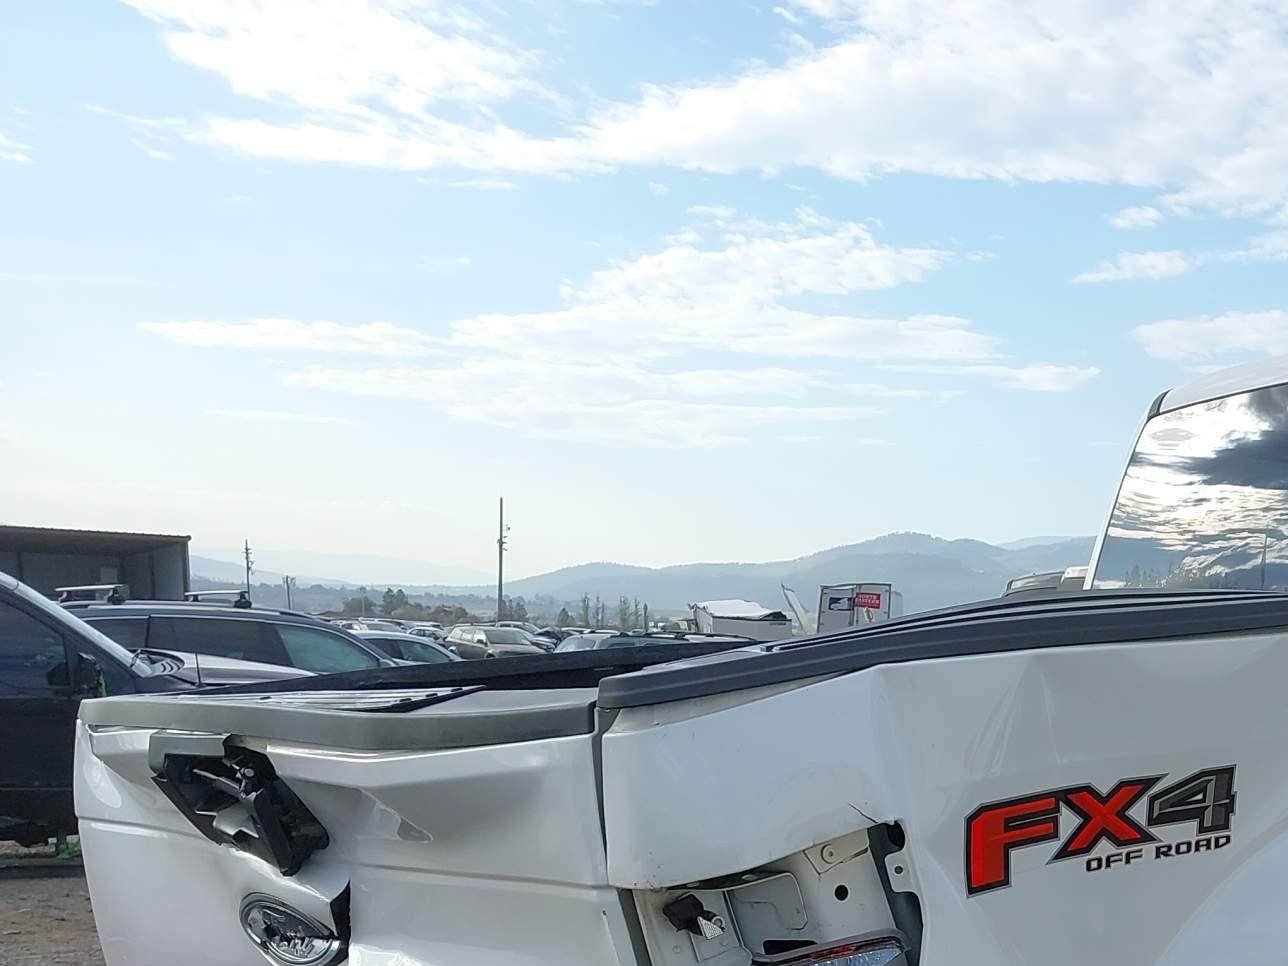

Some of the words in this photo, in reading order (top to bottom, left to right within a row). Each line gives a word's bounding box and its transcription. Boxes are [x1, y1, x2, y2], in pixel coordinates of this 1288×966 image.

[964, 764, 1237, 898] FX4
[1085, 848, 1143, 873] OFF
[1154, 834, 1232, 860] ROAD
